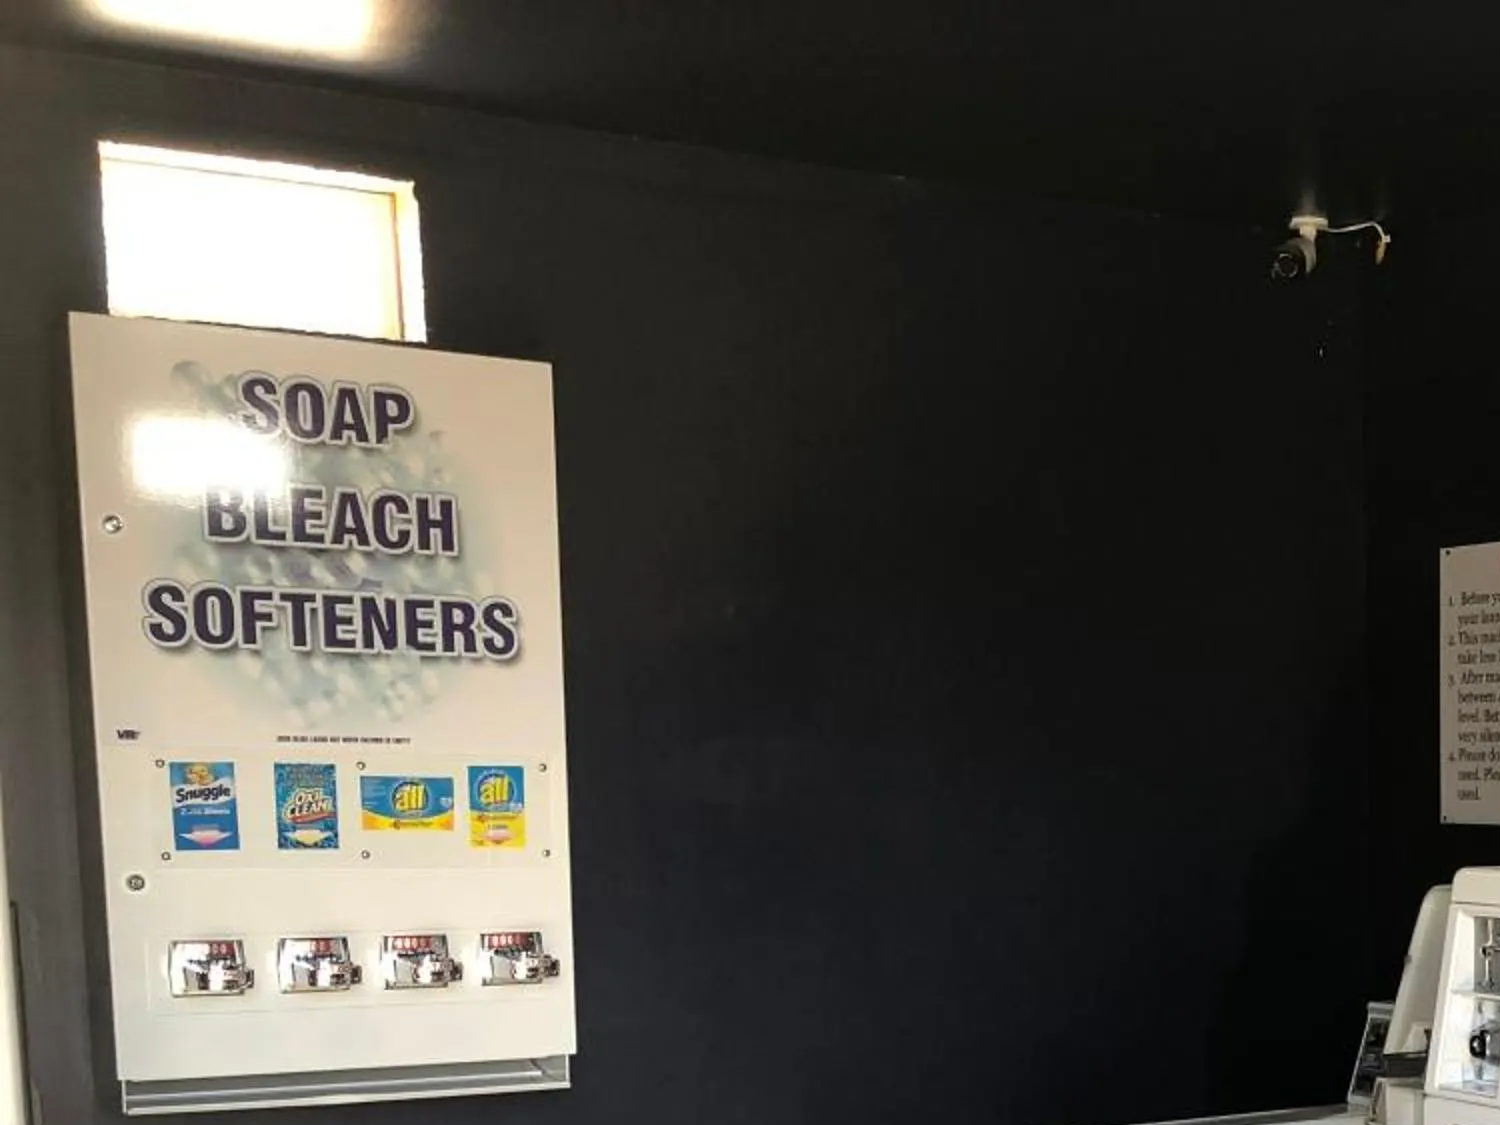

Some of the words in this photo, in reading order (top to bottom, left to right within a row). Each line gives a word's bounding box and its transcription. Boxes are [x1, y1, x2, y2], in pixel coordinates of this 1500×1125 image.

[240, 374, 413, 445] SOAP
[205, 487, 459, 554] BLEACH
[1461, 592, 1490, 605] Before
[147, 582, 518, 656] SOFTENERS
[1458, 615, 1480, 626] your
[1459, 631, 1479, 645] This
[1461, 670, 1485, 684] After
[1458, 689, 1497, 704] between
[1458, 731, 1478, 743] very
[1458, 748, 1486, 763] Please
[1487, 748, 1500, 762] do
[175, 784, 231, 803] Snuggle
[294, 788, 321, 804] OXI
[395, 784, 424, 811] all
[480, 776, 508, 806] all
[286, 799, 333, 818] CLEAN
